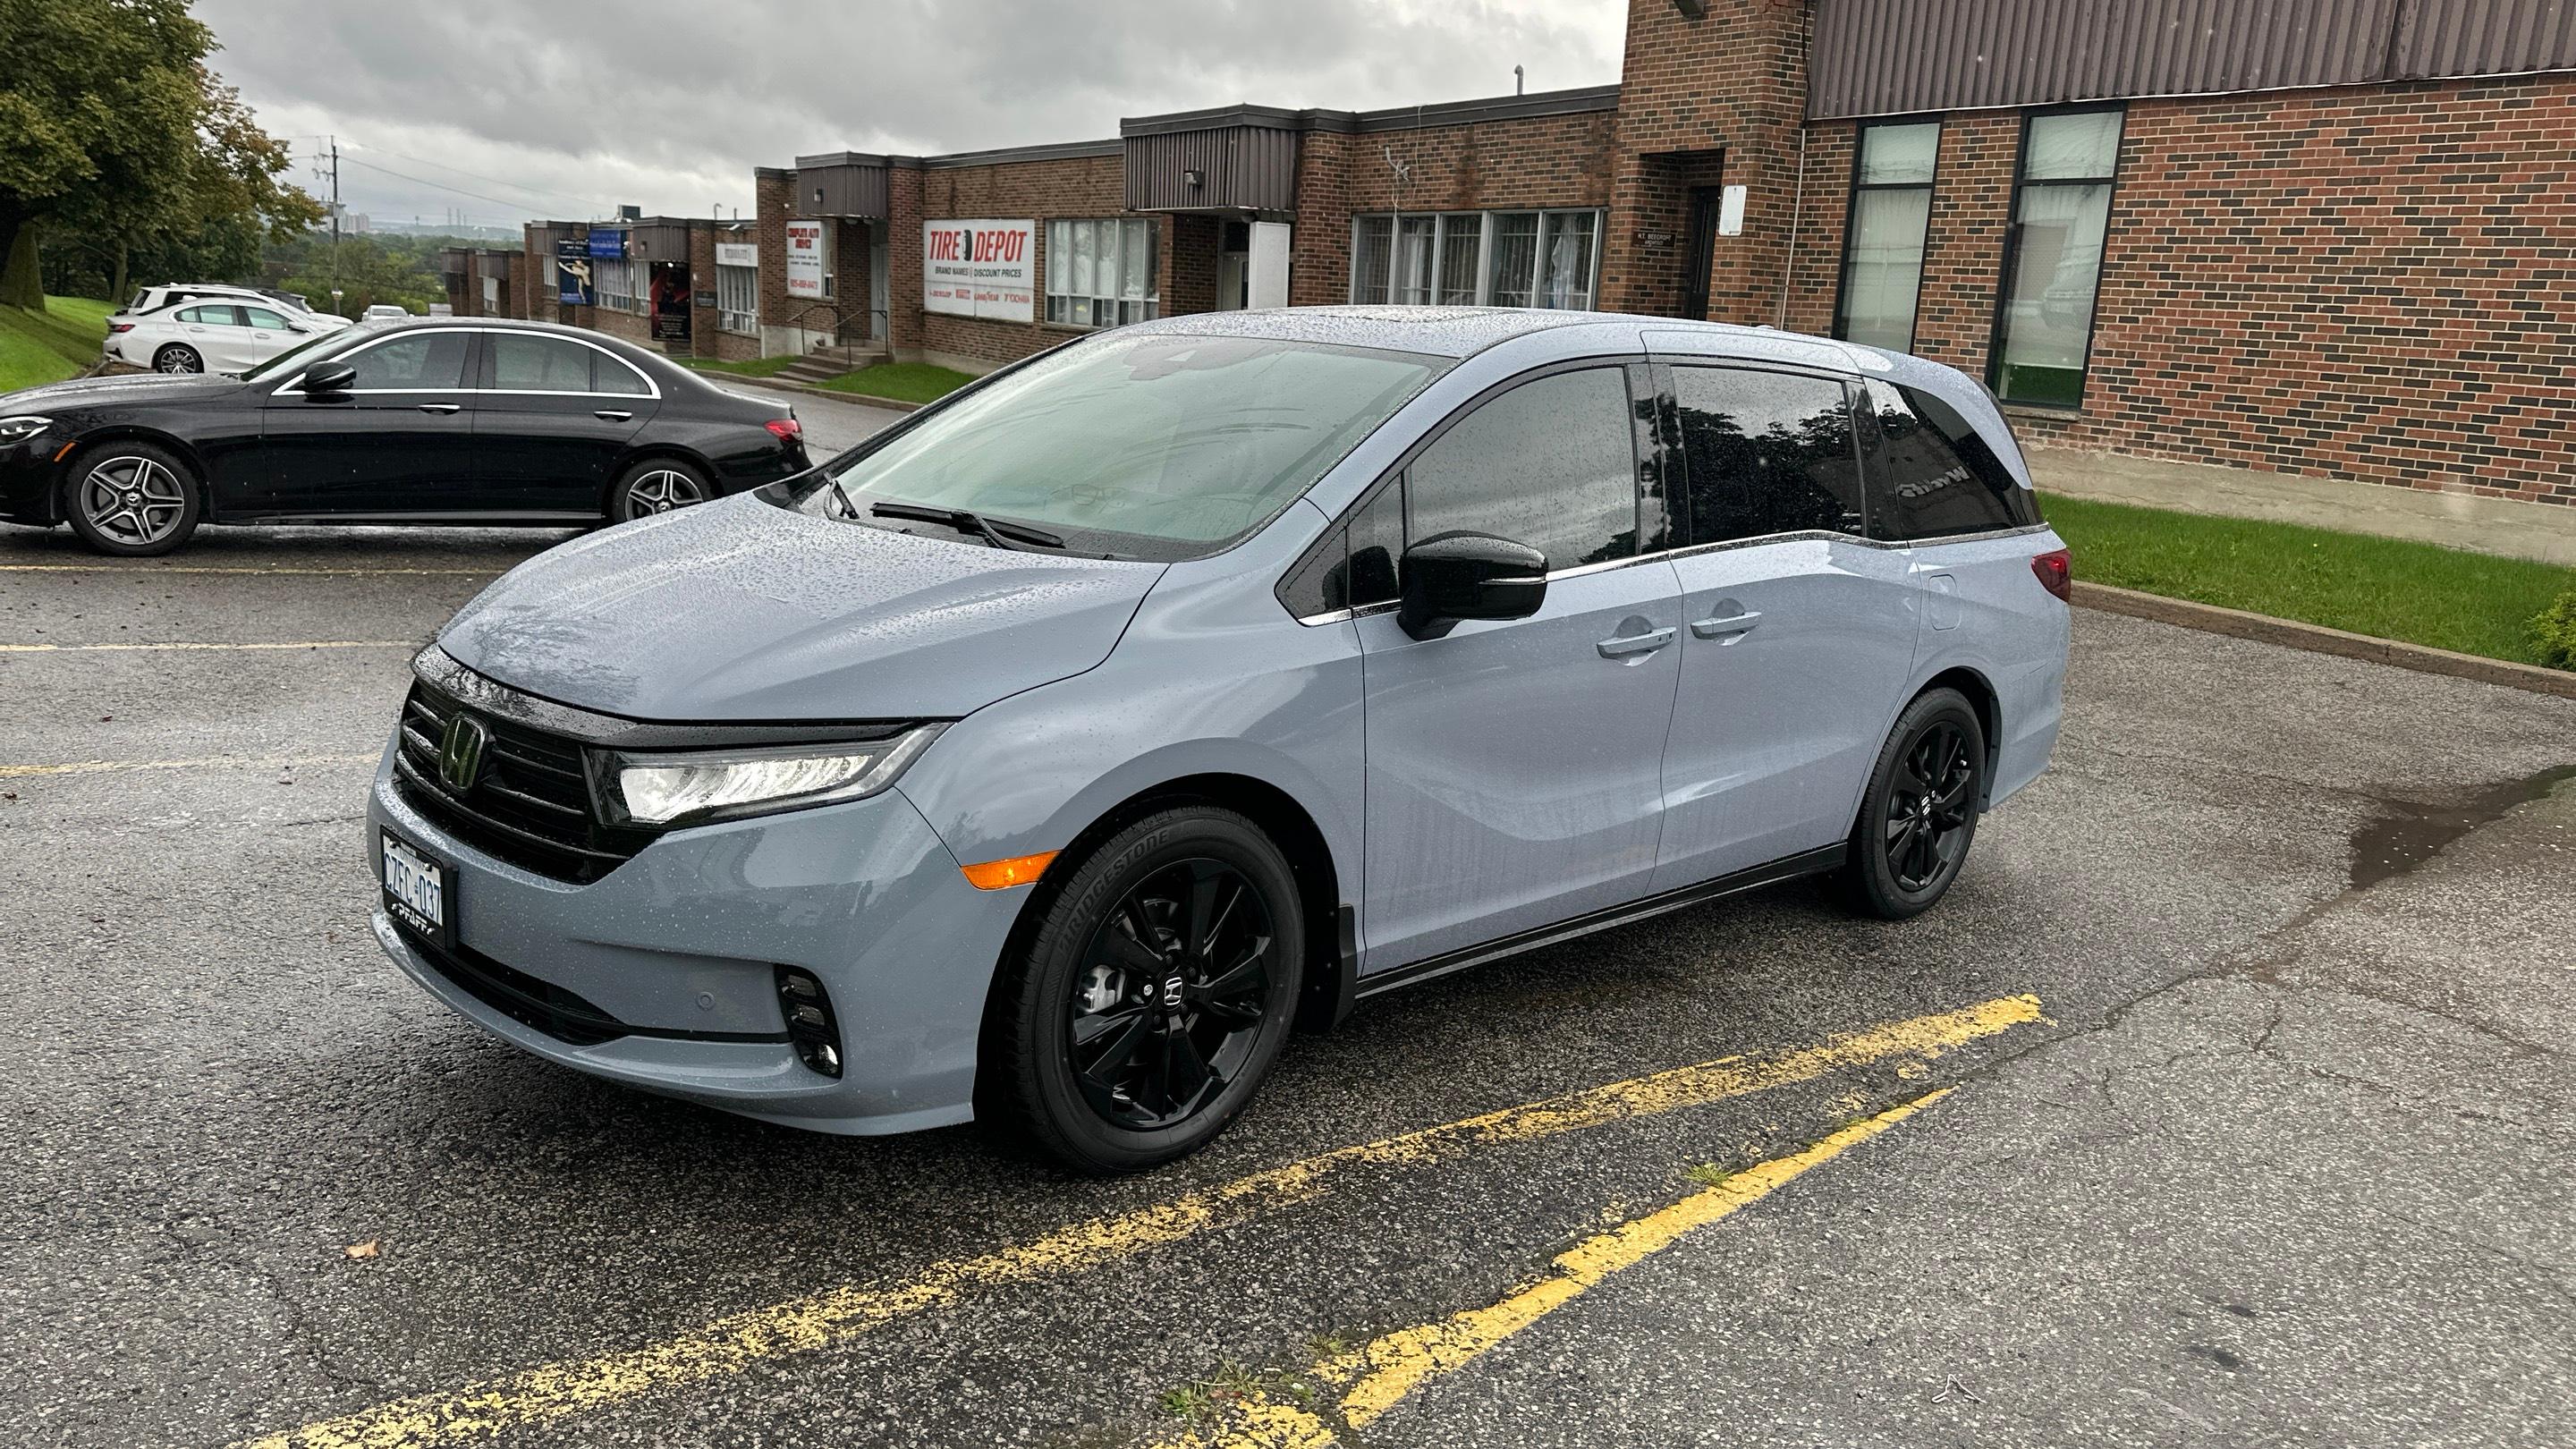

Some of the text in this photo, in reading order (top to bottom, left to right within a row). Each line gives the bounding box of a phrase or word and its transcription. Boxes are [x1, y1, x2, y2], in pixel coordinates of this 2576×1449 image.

[929, 230, 1028, 262] TIRE DEPOT
[935, 266, 1022, 278] BRAND NAMES DISCOUNT PRICES
[1059, 829, 1168, 951] BRIDGESTONE
[398, 902, 428, 932] PFAFF
